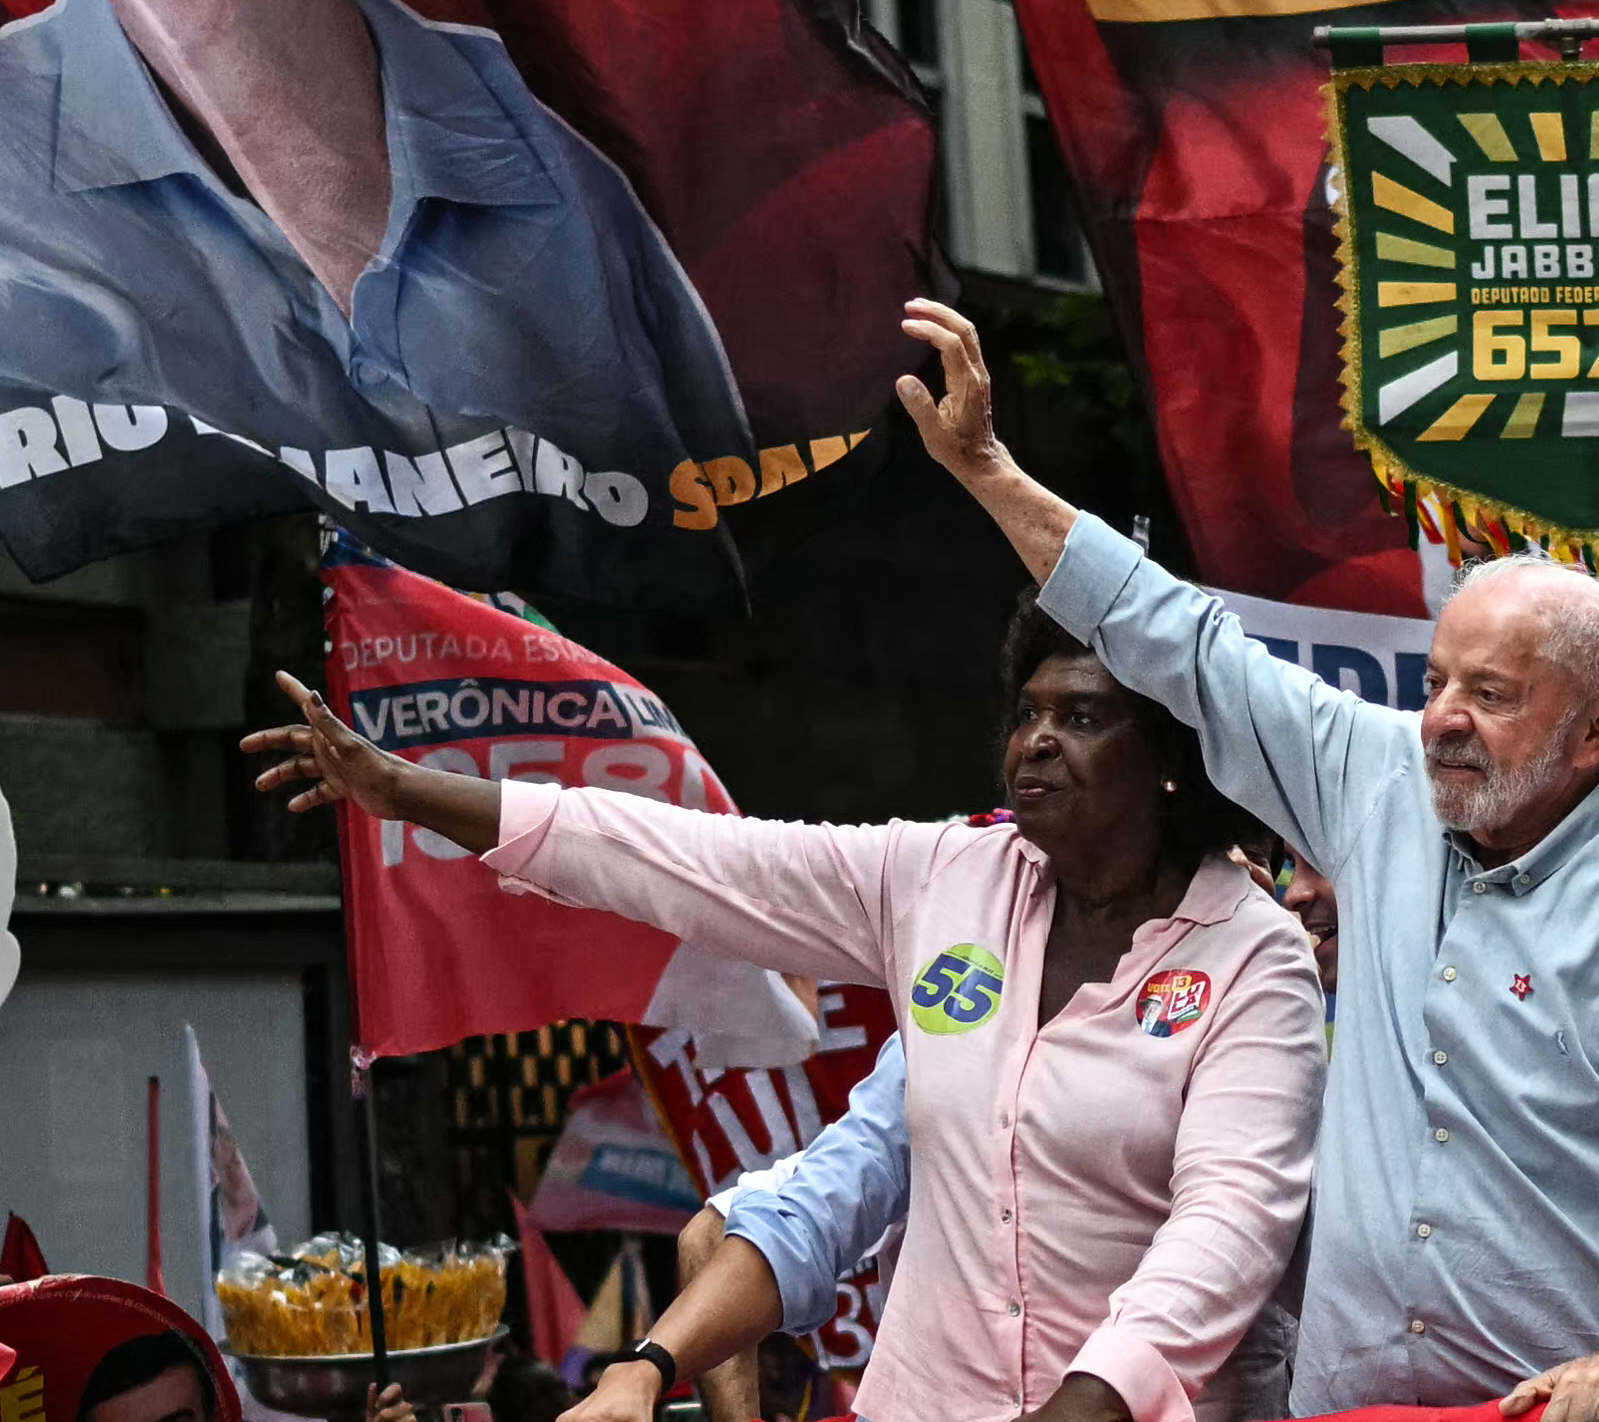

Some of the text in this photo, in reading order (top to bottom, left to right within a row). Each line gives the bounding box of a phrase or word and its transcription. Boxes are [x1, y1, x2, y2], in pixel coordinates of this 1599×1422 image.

[1471, 286, 1550, 304] DEPUTADO
[340, 631, 513, 672] DEPUTADA
[352, 677, 630, 743] VERÔNICA
[911, 952, 1004, 1023] 55
